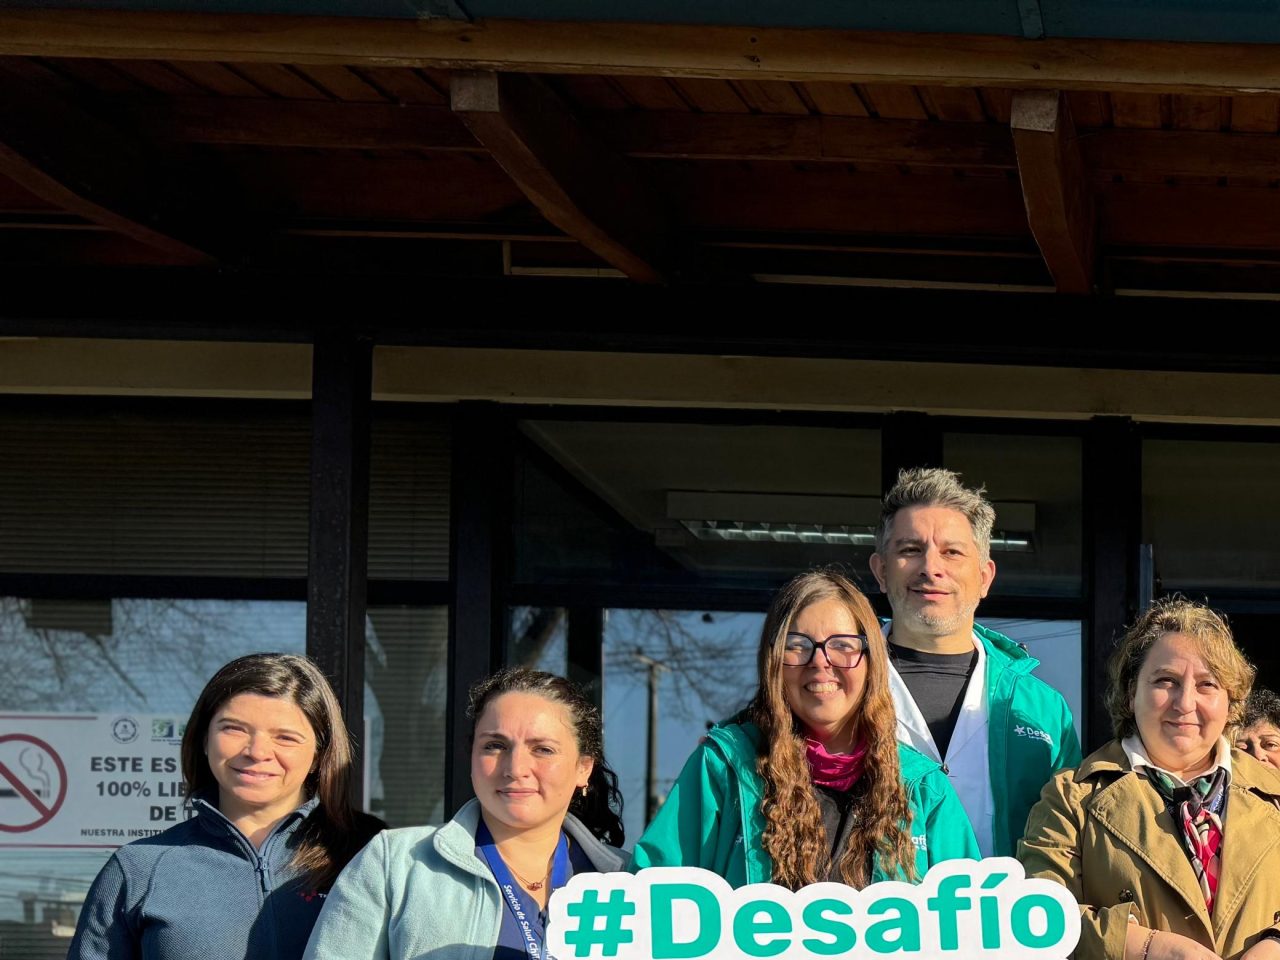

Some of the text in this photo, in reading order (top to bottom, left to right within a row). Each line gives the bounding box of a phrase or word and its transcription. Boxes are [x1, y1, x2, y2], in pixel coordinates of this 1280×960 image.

[91, 757, 177, 773] ESTE ES
[96, 781, 188, 797] 100% LIB
[150, 806, 177, 821] DE
[81, 828, 164, 838] NUESTRA INSTIT
[504, 884, 521, 911] Servicio
[516, 910, 526, 921] de
[521, 920, 536, 942] Salud
[564, 872, 1066, 960] #Desafío
